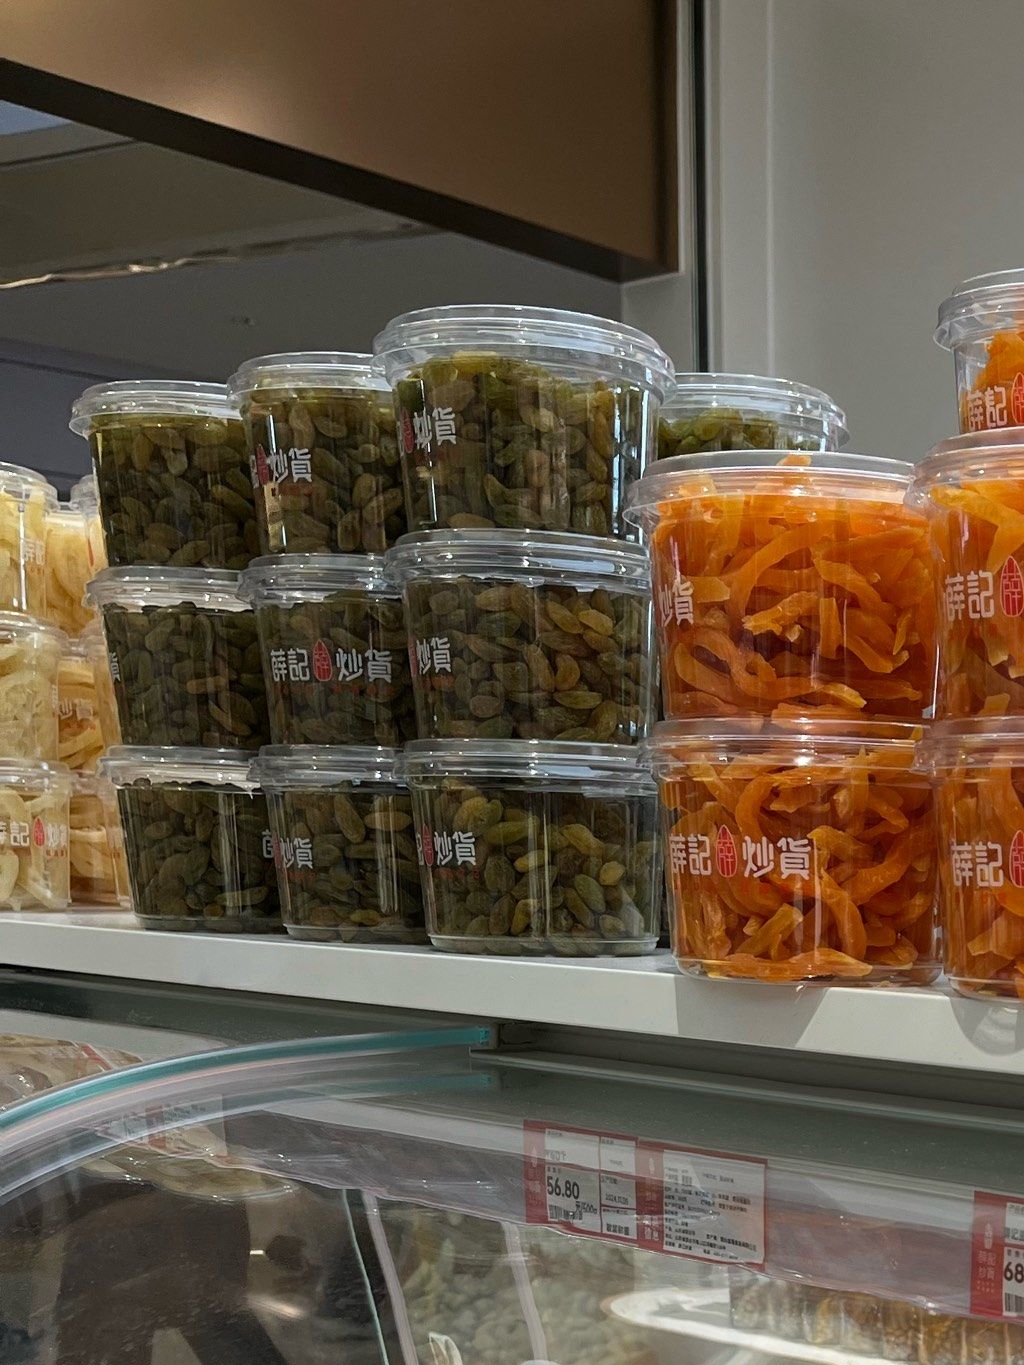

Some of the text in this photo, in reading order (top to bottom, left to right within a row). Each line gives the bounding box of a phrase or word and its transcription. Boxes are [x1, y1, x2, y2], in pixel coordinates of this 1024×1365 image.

[336, 648, 393, 683] 炒貨
[742, 836, 811, 880] 炒貨
[950, 841, 1004, 888] 薛記
[547, 1175, 580, 1199] 56.80
